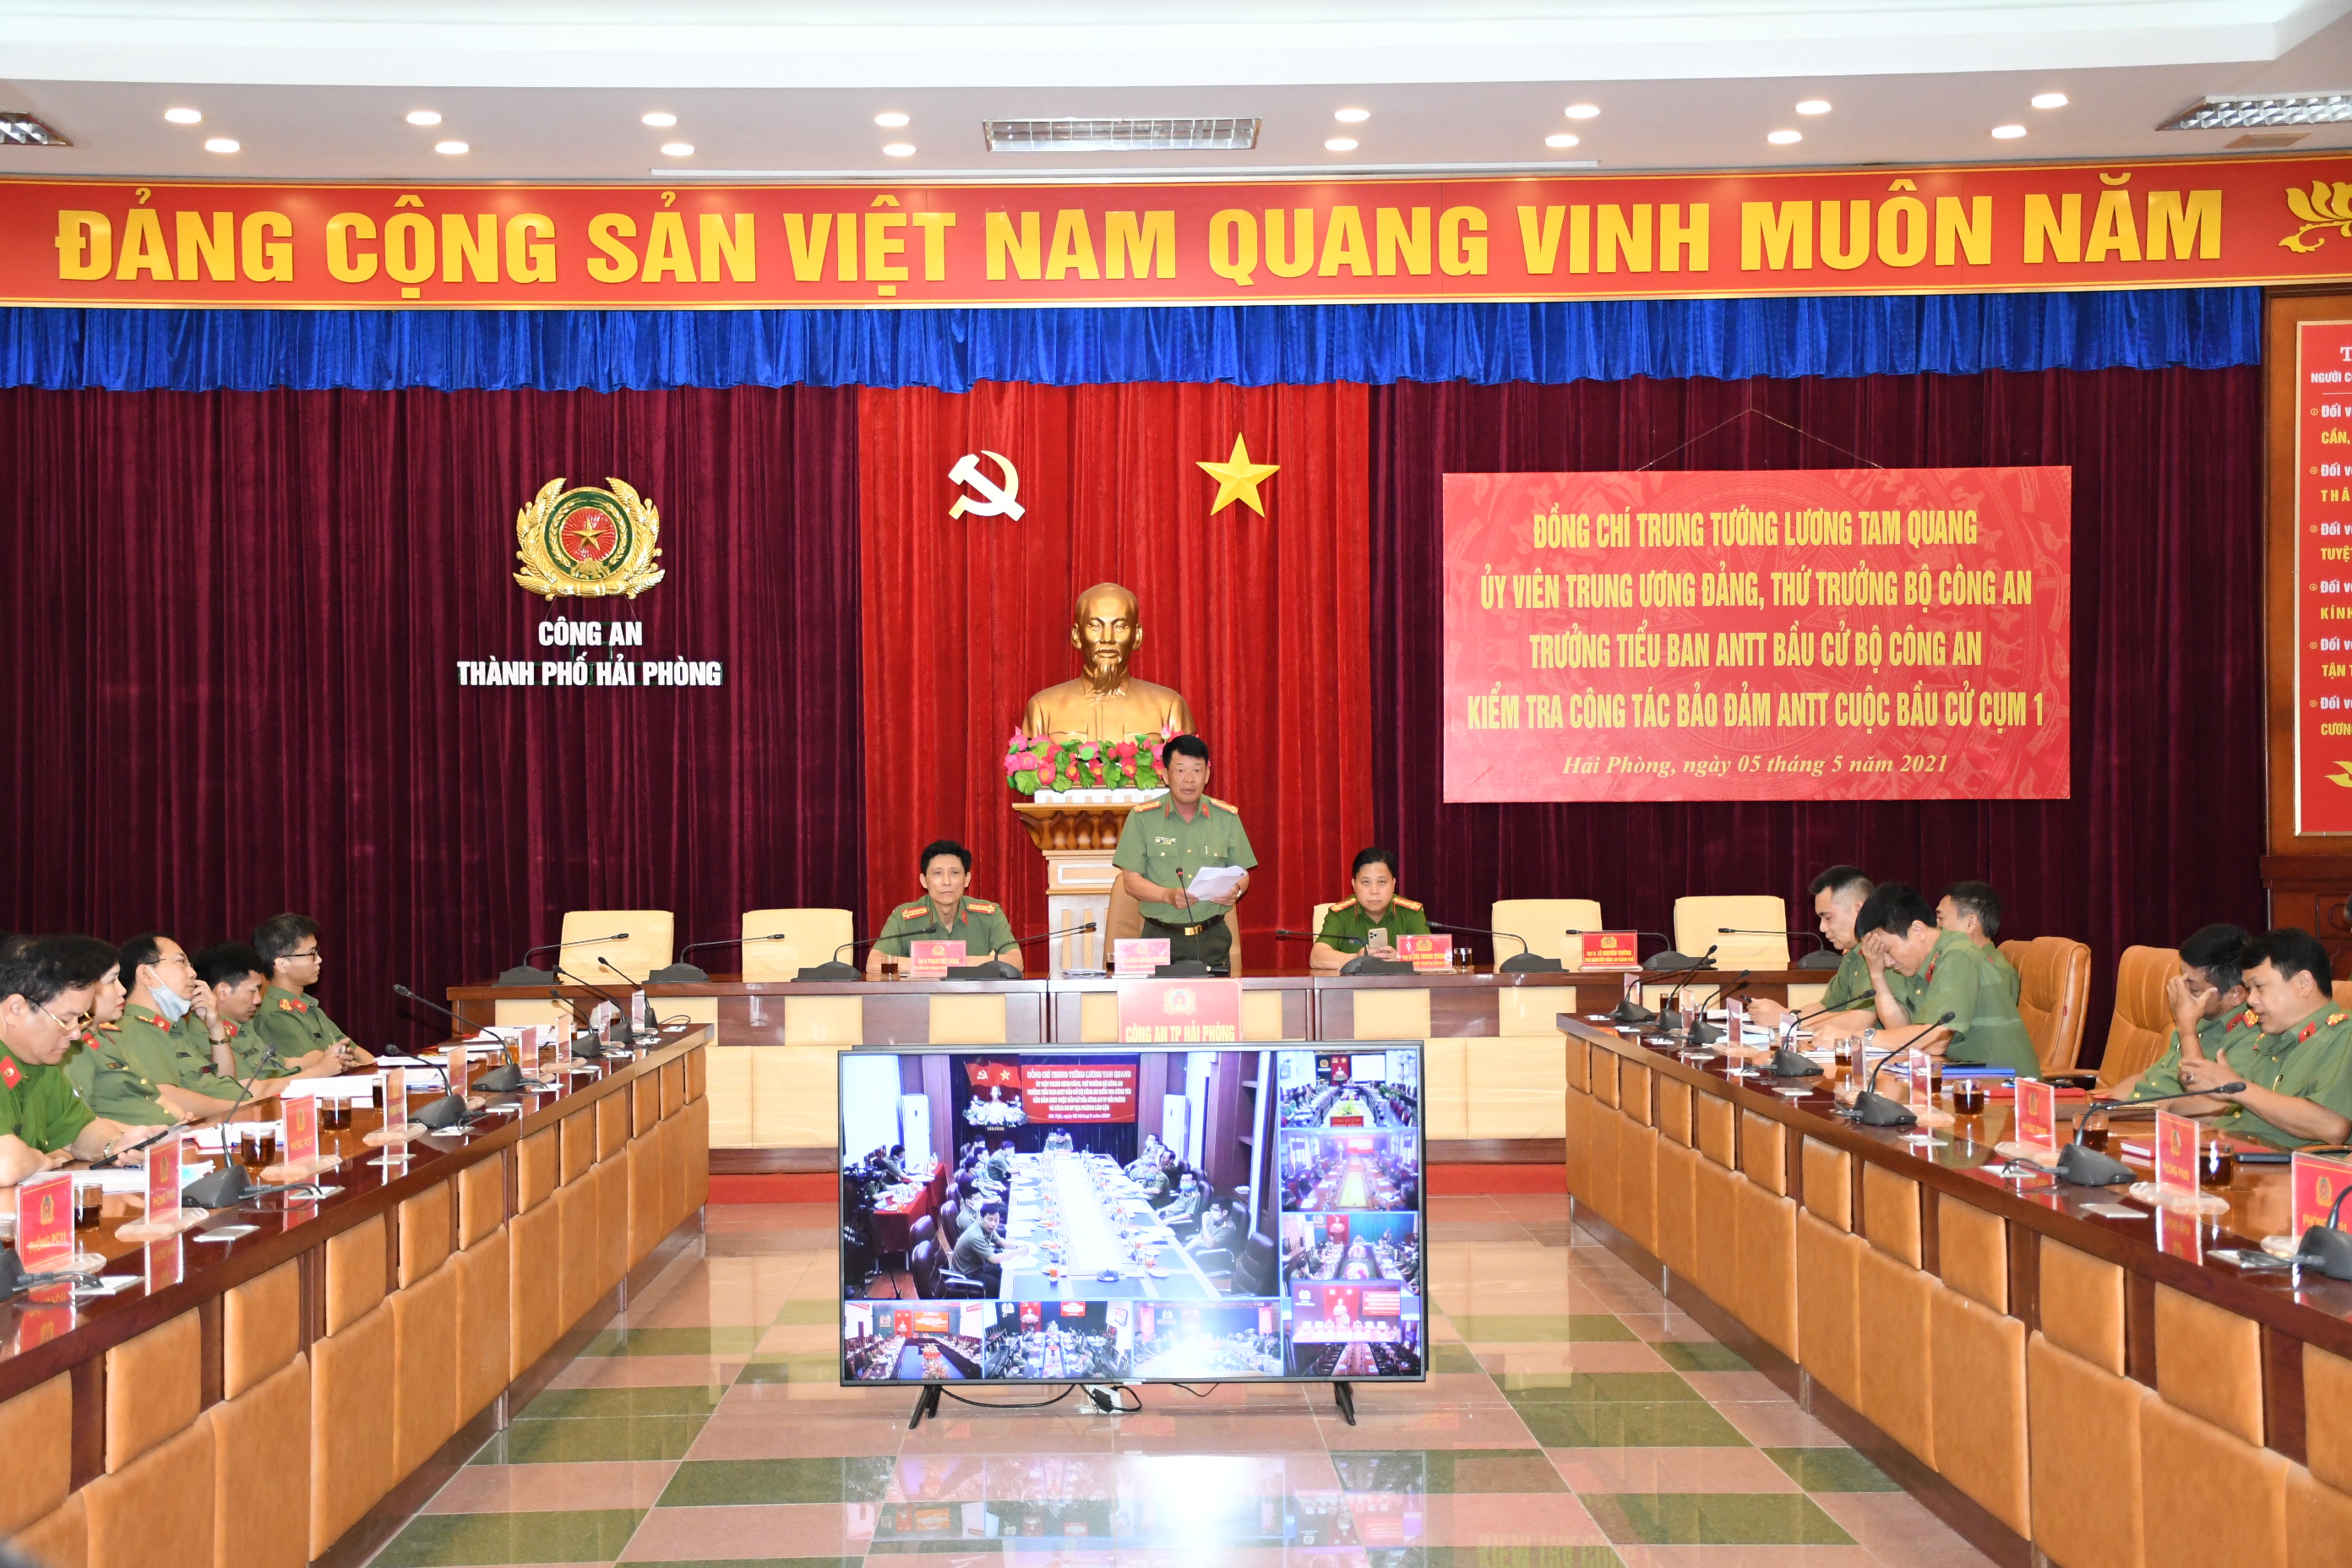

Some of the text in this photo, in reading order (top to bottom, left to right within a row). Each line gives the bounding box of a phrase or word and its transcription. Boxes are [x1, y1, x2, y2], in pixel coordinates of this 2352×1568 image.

[55, 172, 2223, 299] ĐẢNG CỘNG SẢN VIỆT NAM QUANG VINH MUÔN NĂM
[2321, 403, 2342, 418] Đối
[2320, 462, 2341, 477] Đối
[1533, 503, 1978, 549] ĐỒNG CHÍ TRUNG TƯỚNG LƯƠNG TAM QUANG
[2320, 520, 2341, 536] Đối
[2320, 545, 2352, 563] TUYỆ
[1481, 560, 2031, 612] ỦY VIÊN TRUNG ƯƠNG ĐẢNG, THỨ TRƯỞNG BỘ CÔNG AN
[2320, 579, 2340, 593] Đối
[539, 616, 643, 646] CÔNG AN
[1529, 619, 1981, 673] TRƯỞNG TIỂU BAN ANTT BẦU CỬ BỘ CÔNG AN
[2320, 636, 2340, 651] Đối
[457, 651, 721, 686] THÀNH PHỐ HẢI PHÒNG
[2321, 662, 2346, 680] TẬN
[1468, 680, 2043, 734] KIỂM TRA CÔNG TÁC BẢO ĐẢM ANTT CUỘC BẦU CỬ CỤM 1
[2320, 694, 2340, 710] Đối
[2321, 721, 2352, 736] CƯƠN
[1562, 754, 1948, 778] Hải Phòng, ngày 05 tháng 5 năm 2021
[1125, 1020, 1235, 1043] CÔNG AN TP HẢI PHÒNG
[29, 1230, 67, 1255] PHÒNG PC11
